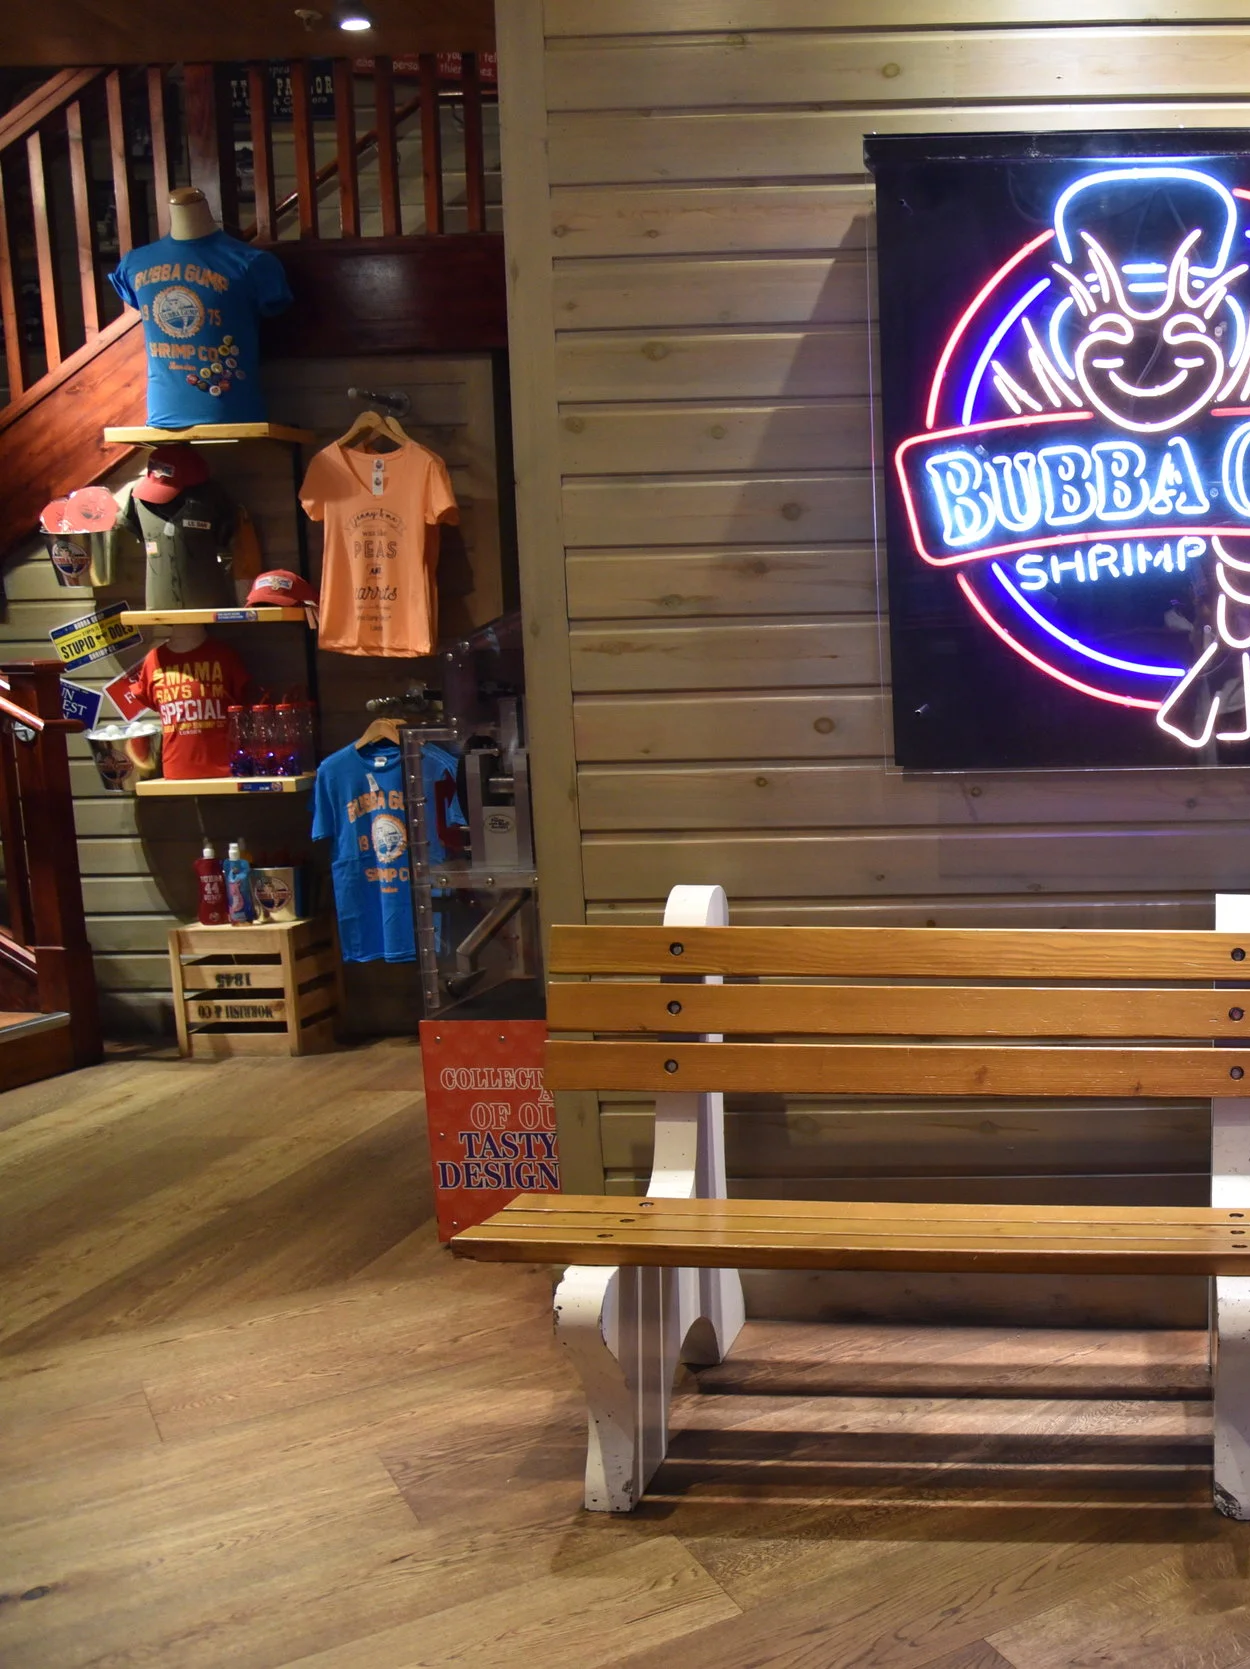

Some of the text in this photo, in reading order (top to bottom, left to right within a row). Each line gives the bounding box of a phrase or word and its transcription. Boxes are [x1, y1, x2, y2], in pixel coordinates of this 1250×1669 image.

[207, 308, 223, 326] 75
[926, 435, 1211, 548] BUBBA
[353, 540, 398, 559] PEAS
[1015, 535, 1208, 591] SHRIMP
[60, 634, 96, 660] STUPID
[165, 661, 223, 686] MAMA
[156, 684, 192, 704] SAYS
[160, 699, 227, 725] SPECIAL
[214, 972, 252, 989] 1845
[470, 1102, 511, 1130] OF
[458, 1131, 557, 1161] TASTY
